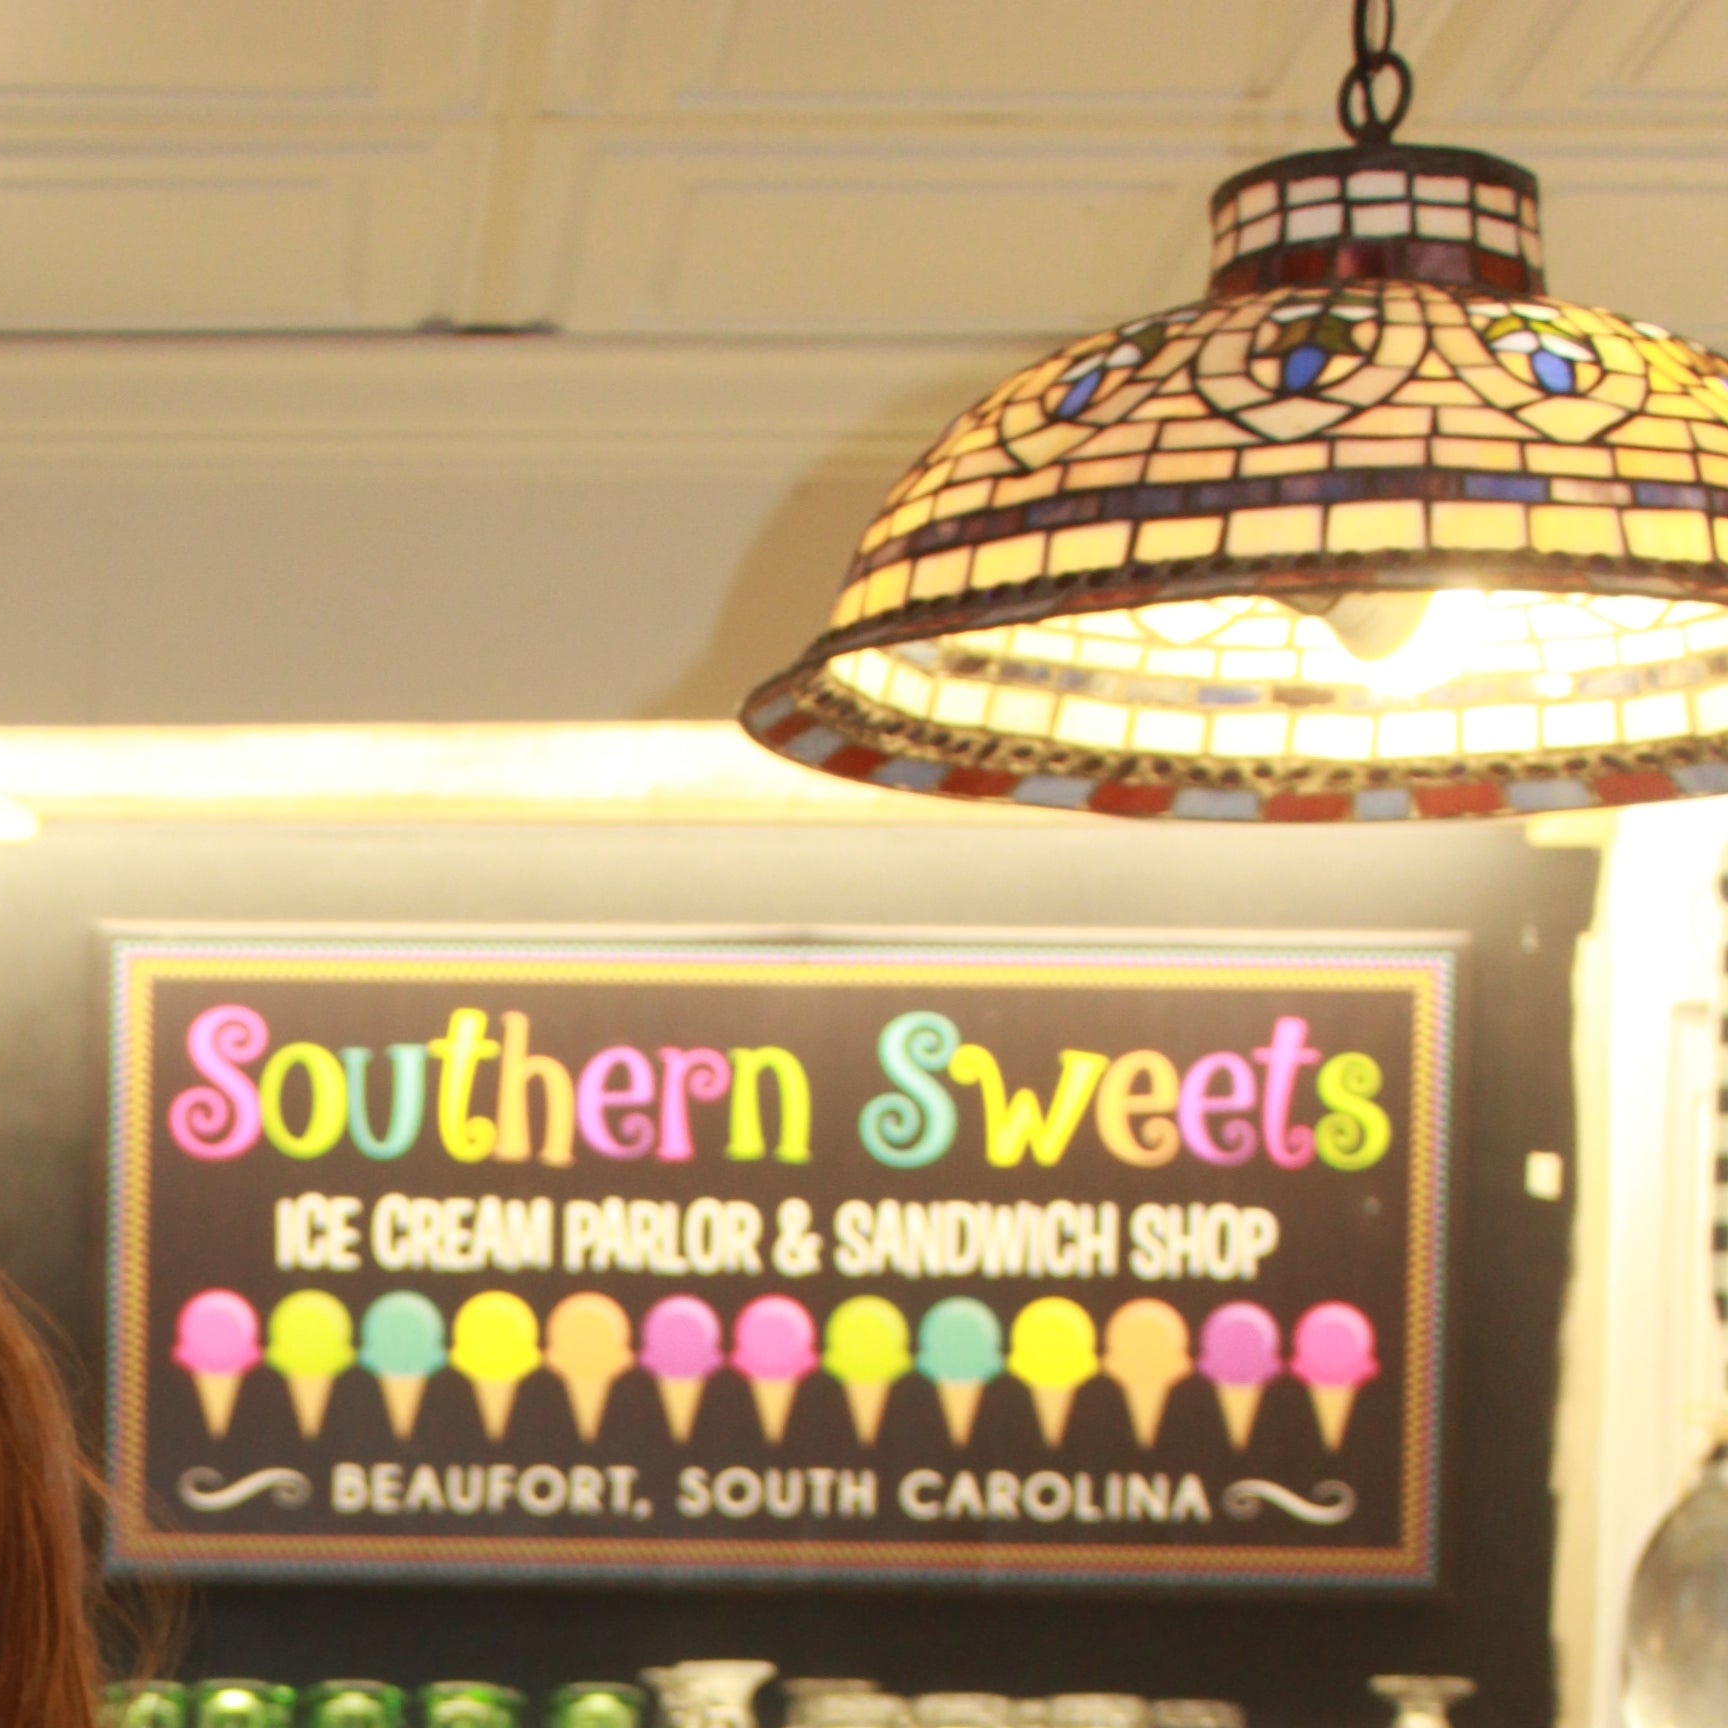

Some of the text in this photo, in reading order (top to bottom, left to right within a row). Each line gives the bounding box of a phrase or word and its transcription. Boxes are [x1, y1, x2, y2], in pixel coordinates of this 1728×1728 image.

[168, 1004, 1392, 1172] Southern Sweets
[276, 1193, 1278, 1280] ICE CREAM PARLOR & SANDWICH SHOP
[332, 1463, 1212, 1522] BEAUFORT, SOUTH CAROLINA
